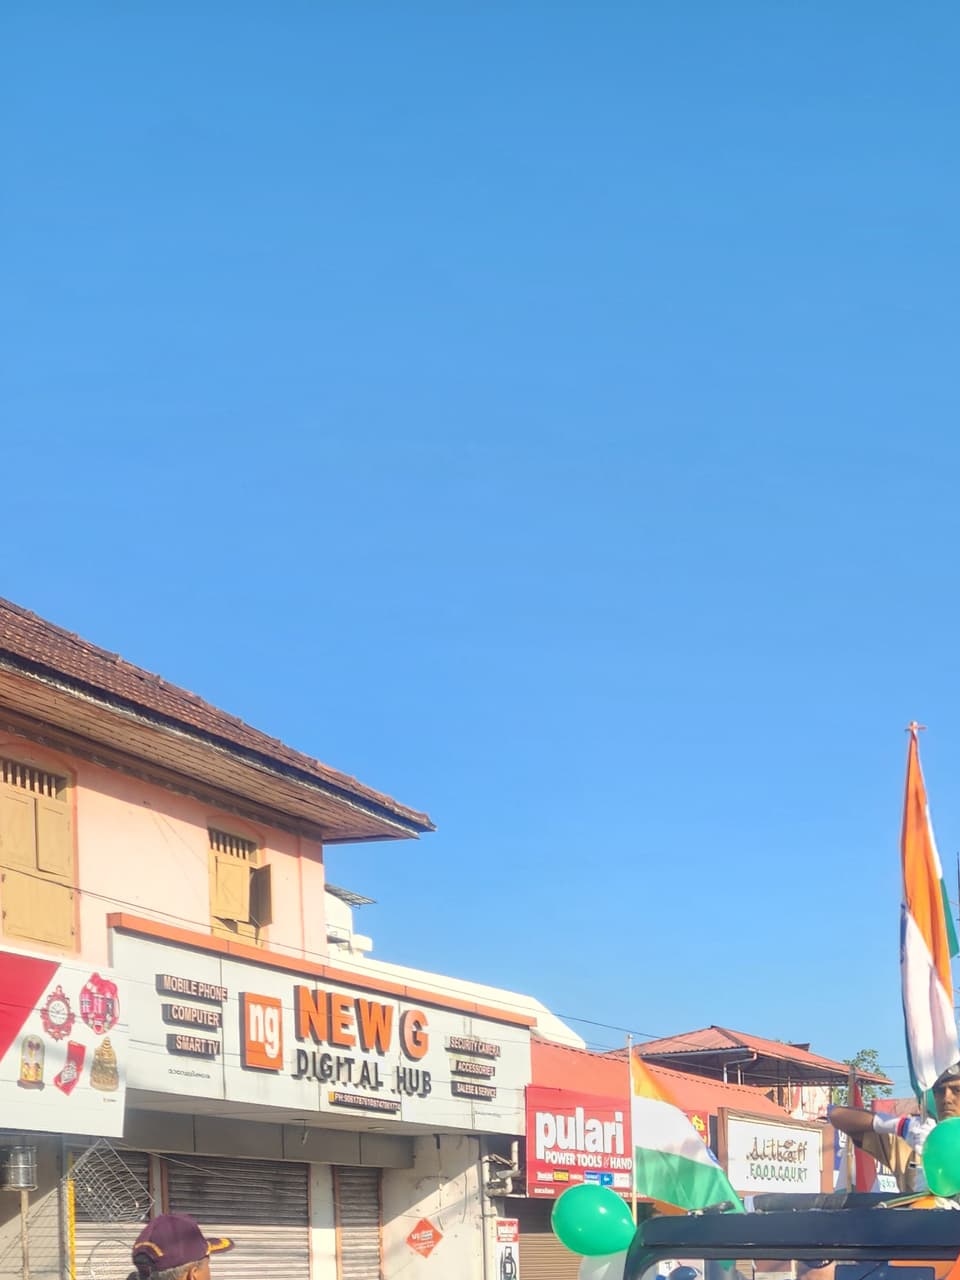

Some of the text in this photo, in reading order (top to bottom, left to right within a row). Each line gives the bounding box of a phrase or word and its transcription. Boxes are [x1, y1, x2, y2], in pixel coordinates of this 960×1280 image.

[163, 975, 228, 1002] MOBILE PHONE
[171, 1004, 220, 1026] COMPUTER
[295, 985, 429, 1061] NEW G
[175, 1035, 220, 1055] SMART TV
[450, 1037, 501, 1057] SECURITY CAMERA
[296, 1048, 432, 1095] DIGITAL HUB
[457, 1062, 494, 1076] ACCESSORIES
[535, 1106, 624, 1160] pulari
[545, 1152, 576, 1166] POWER
[577, 1153, 602, 1168] TOOLS
[610, 1157, 633, 1170] HAND
